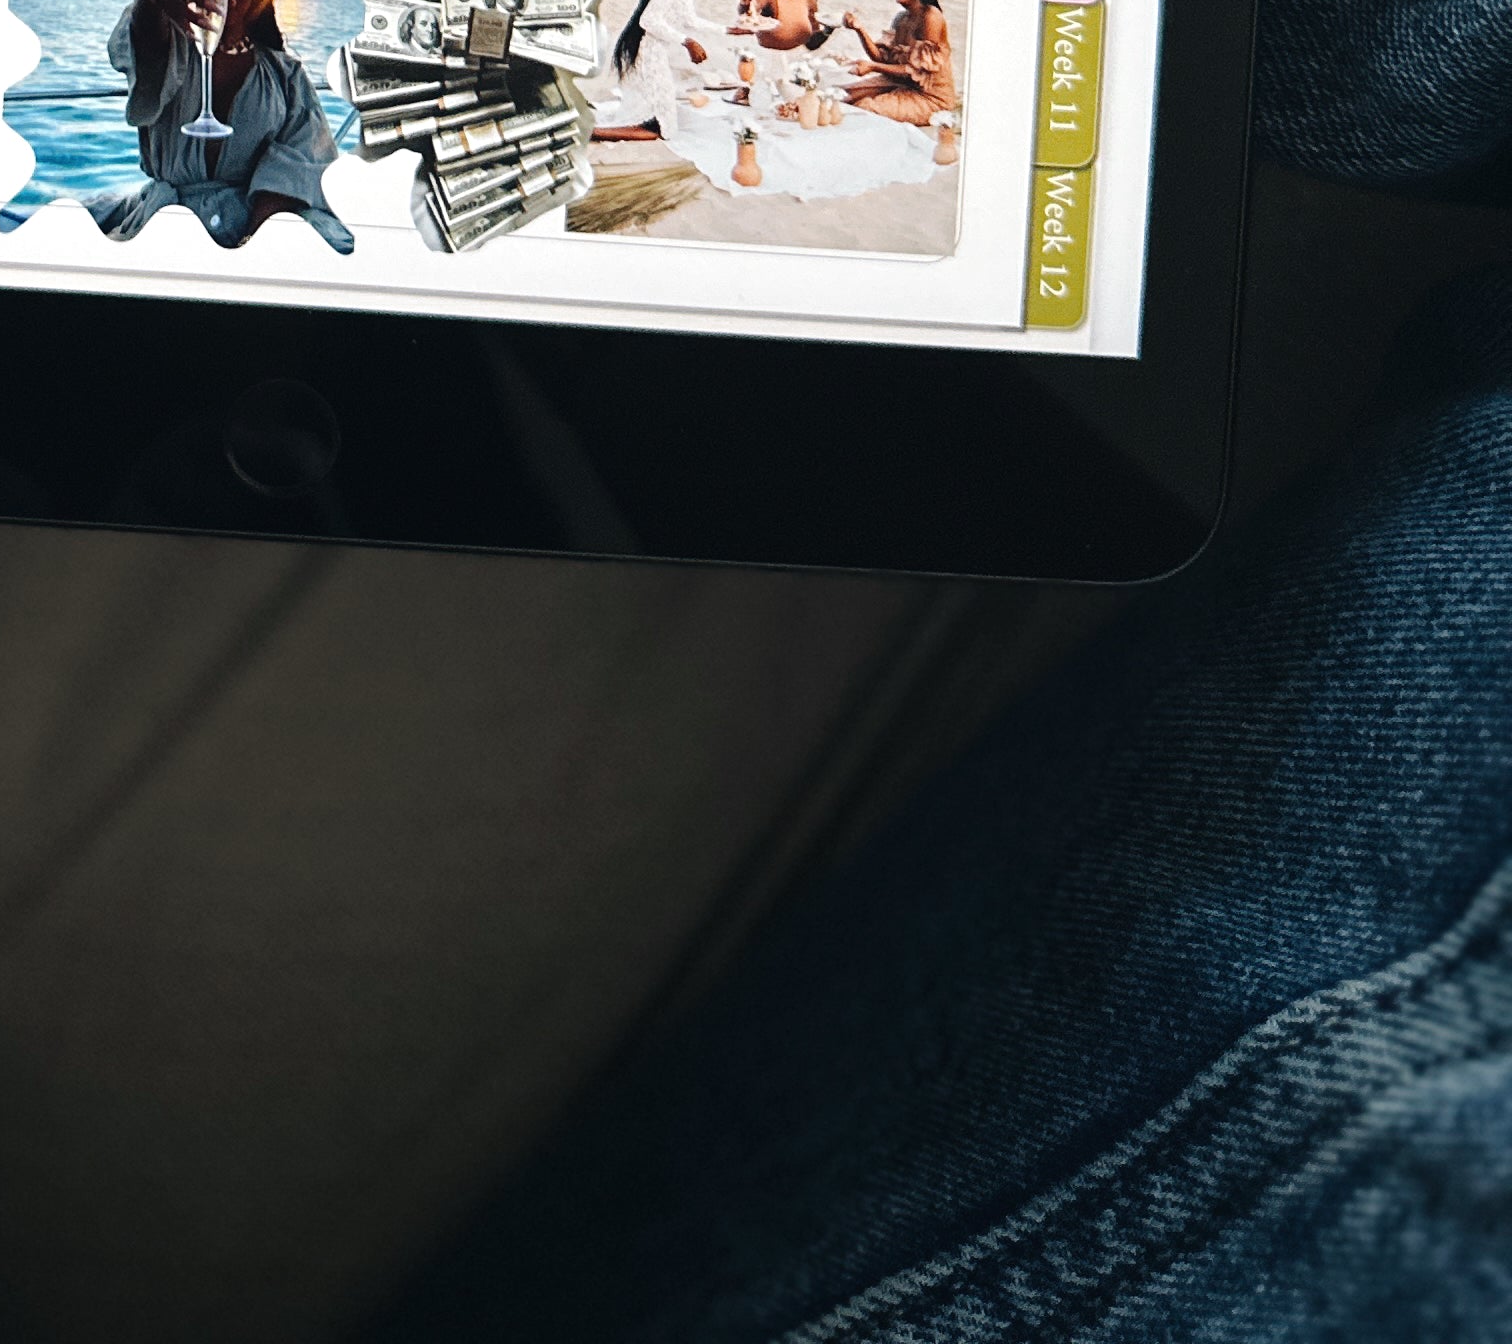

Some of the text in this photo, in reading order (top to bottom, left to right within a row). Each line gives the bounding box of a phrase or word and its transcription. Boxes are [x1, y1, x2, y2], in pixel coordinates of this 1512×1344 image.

[1049, 6, 1086, 132] Week 11
[1040, 169, 1076, 298] Week 12
